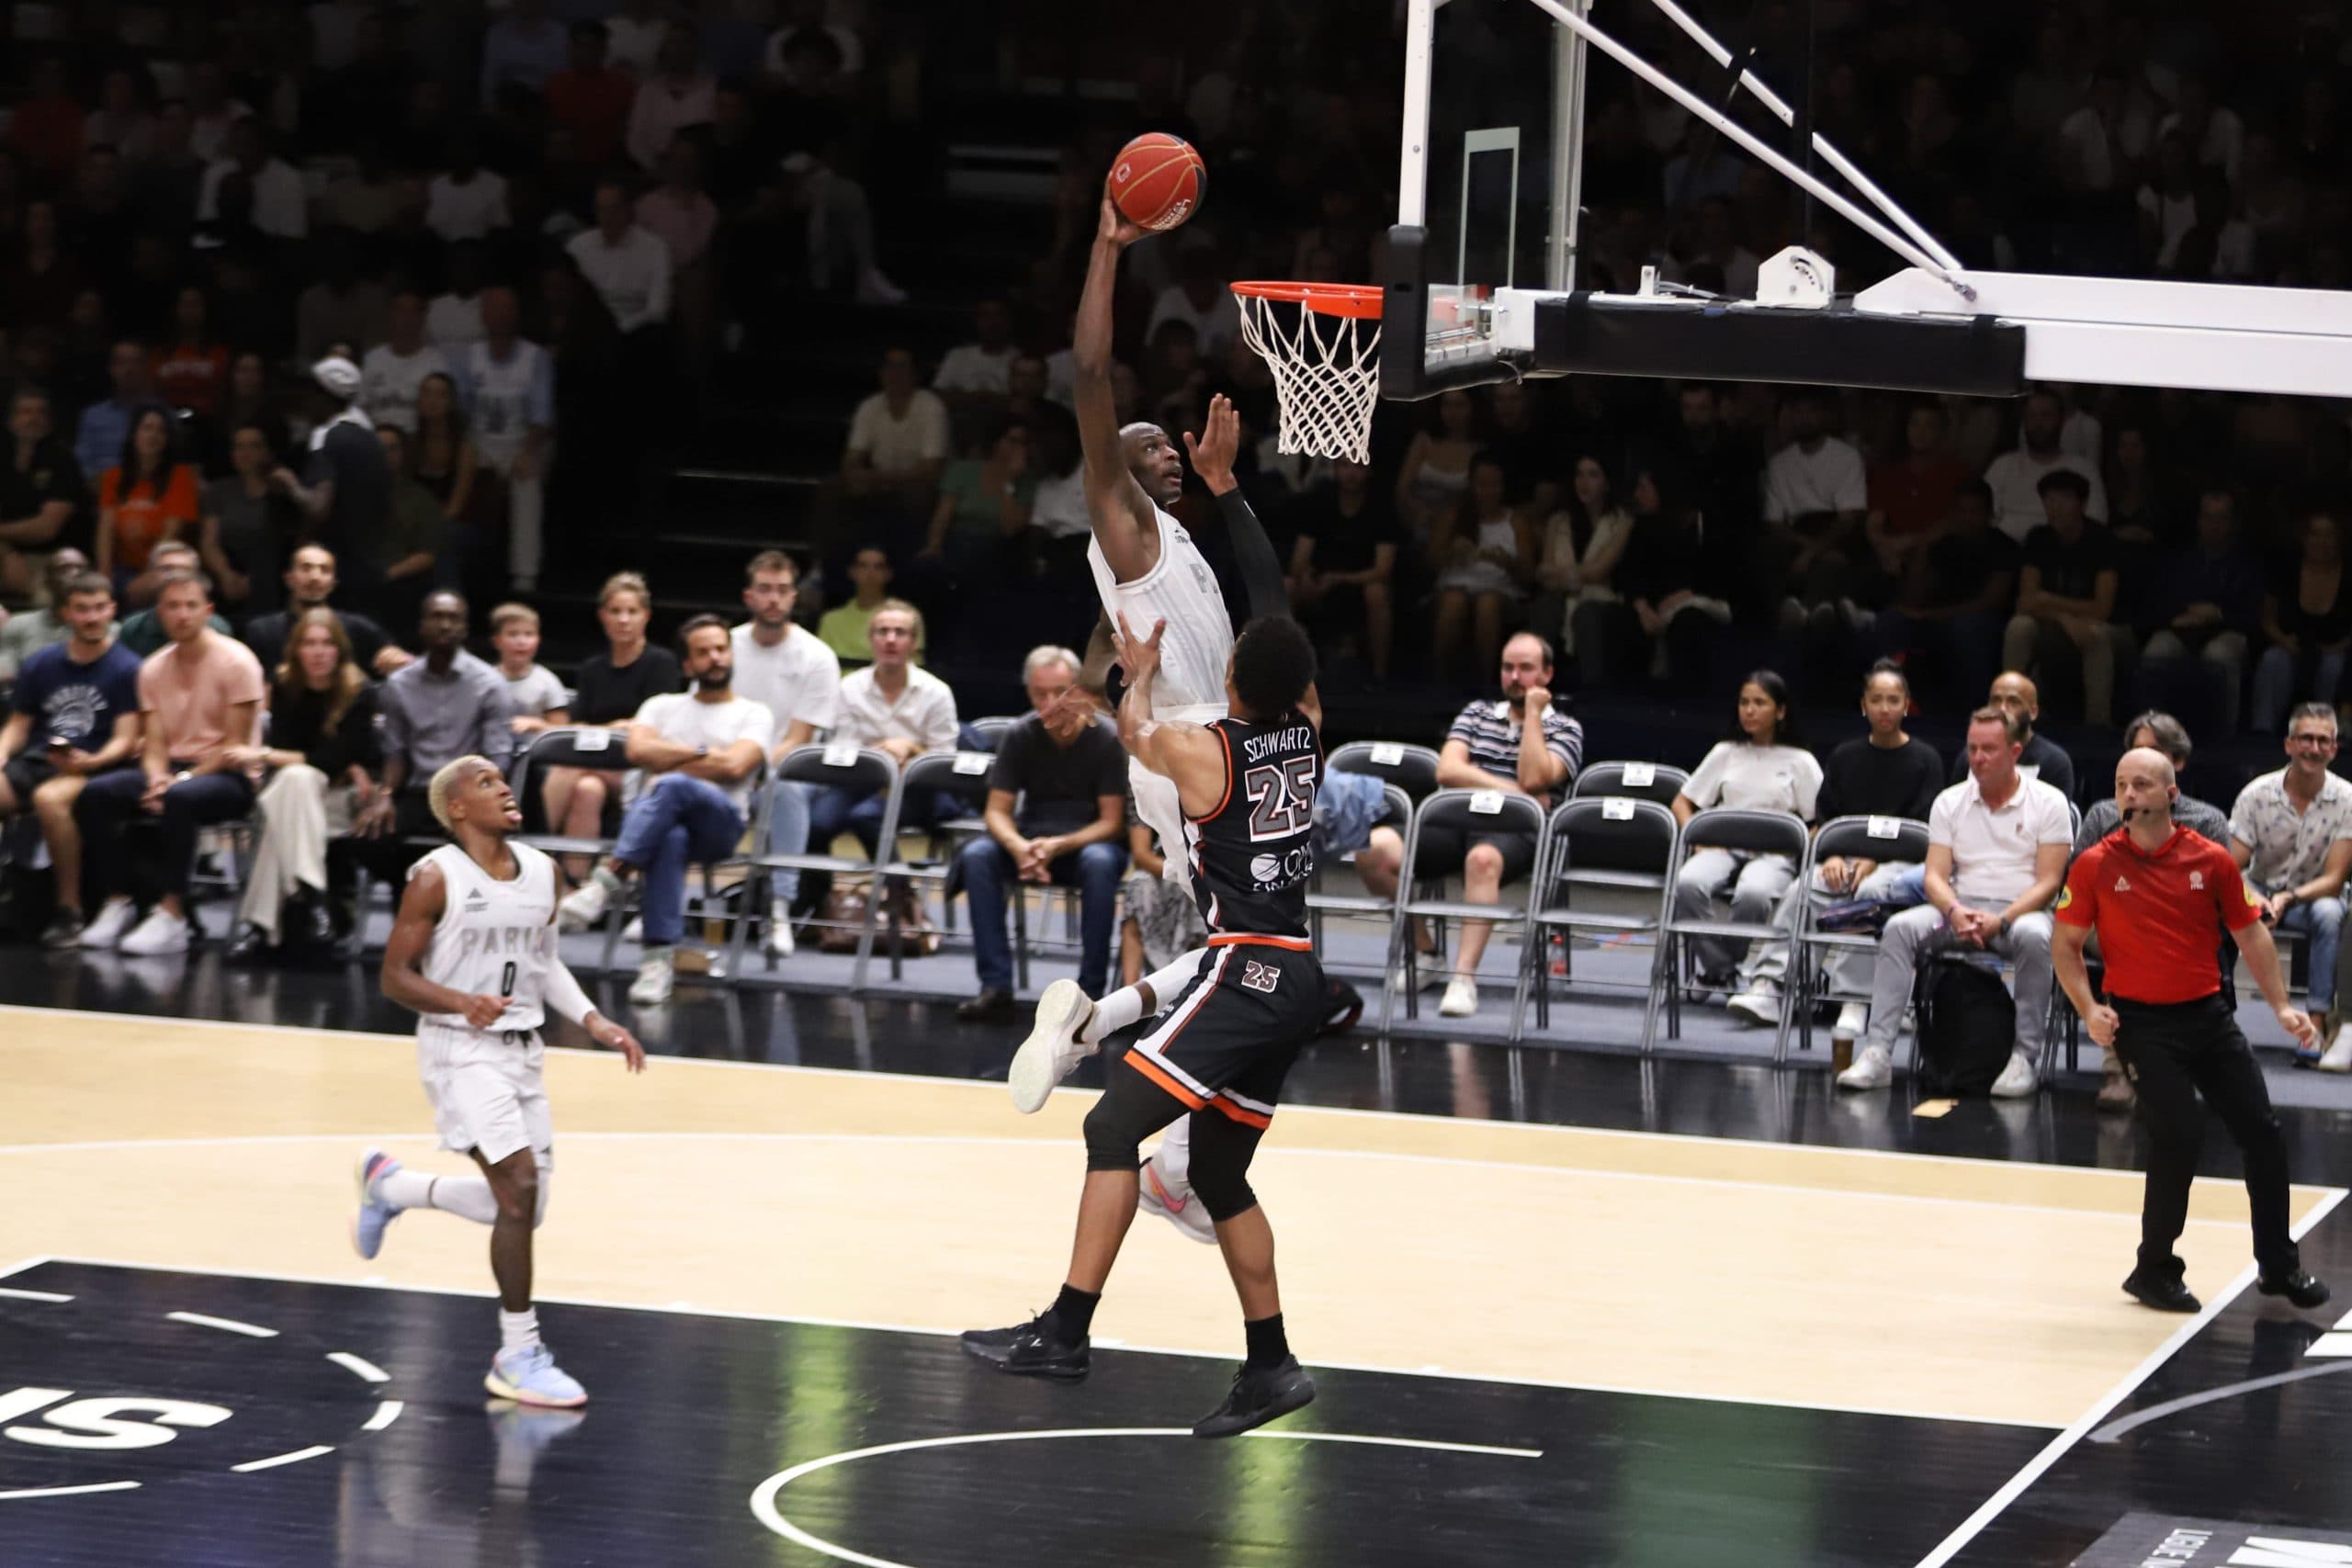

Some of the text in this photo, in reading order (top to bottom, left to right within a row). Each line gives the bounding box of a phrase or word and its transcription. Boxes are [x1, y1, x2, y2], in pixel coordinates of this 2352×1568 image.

[1245, 754, 1316, 842] 25
[502, 961, 517, 997] 0
[1241, 960, 1281, 993] 25
